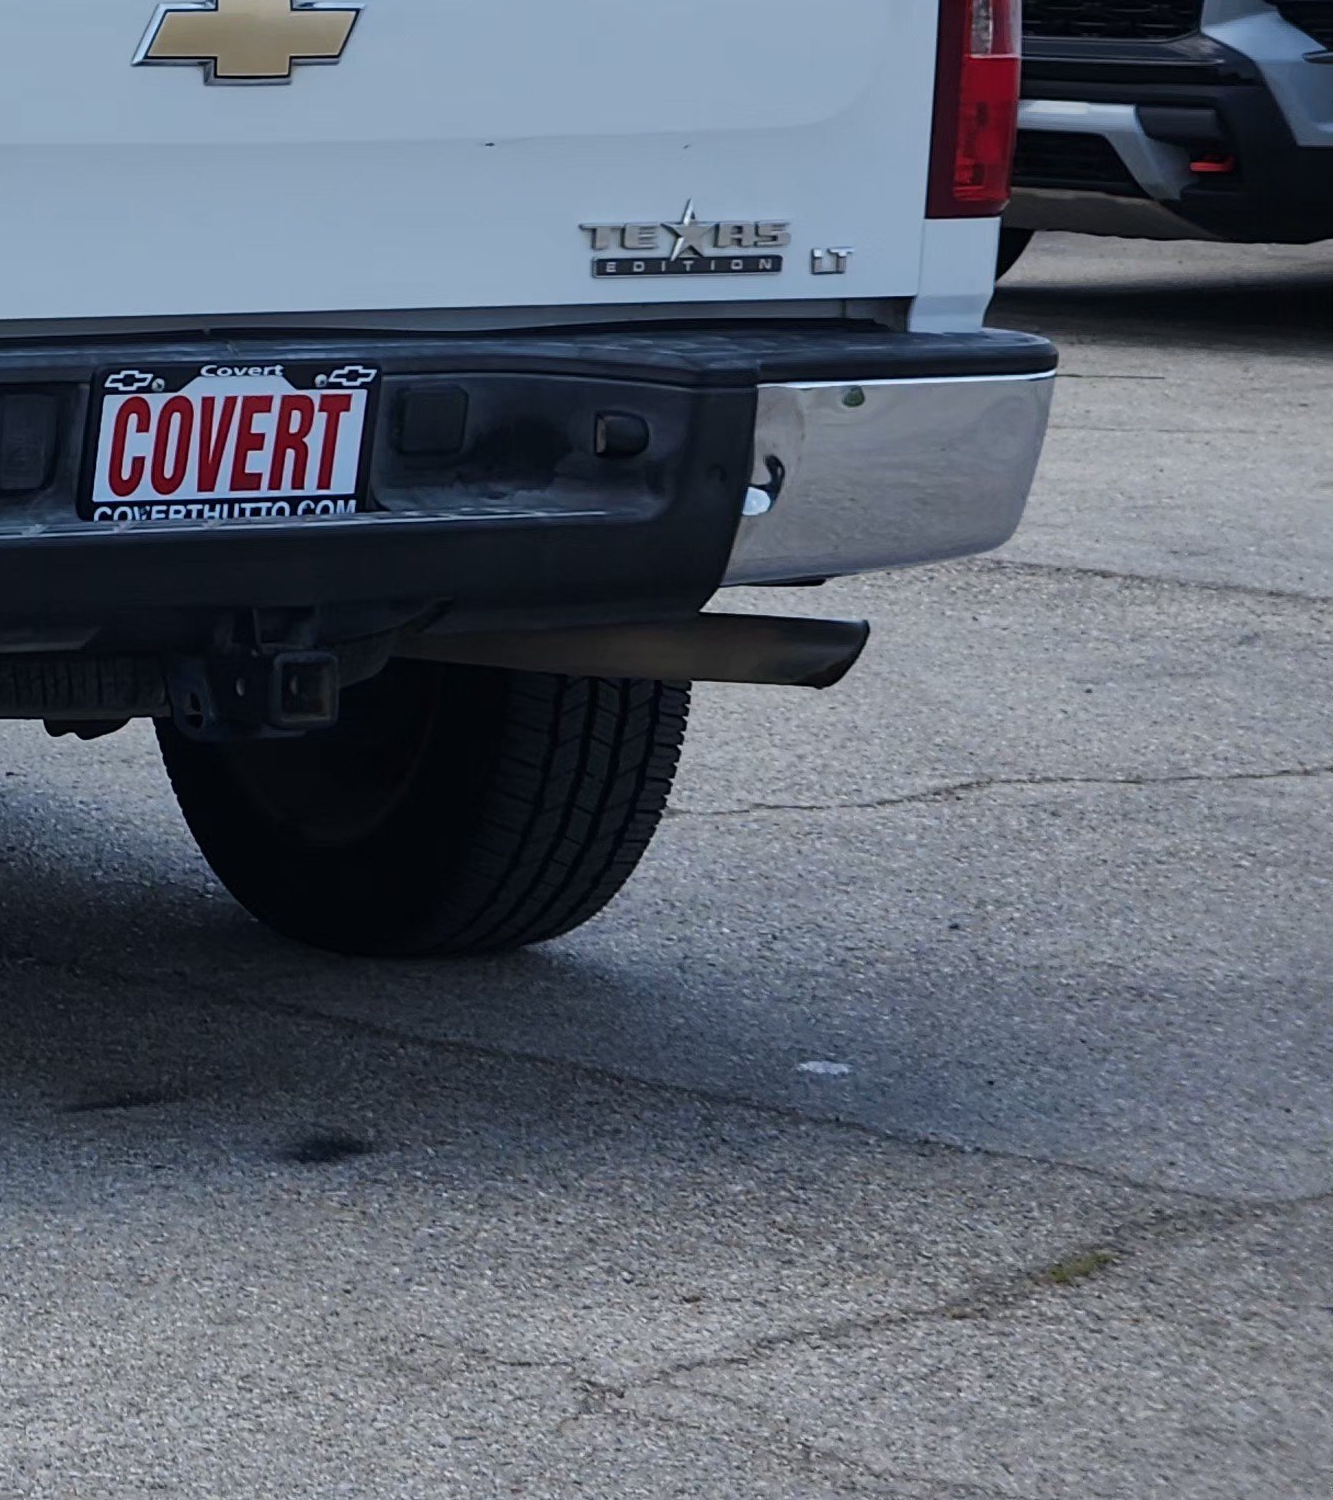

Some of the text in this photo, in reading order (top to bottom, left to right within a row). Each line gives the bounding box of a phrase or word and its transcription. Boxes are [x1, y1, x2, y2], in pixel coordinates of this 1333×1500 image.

[604, 257, 774, 274] EDITION
[810, 246, 854, 275] LT
[199, 363, 285, 378] Covert
[107, 393, 353, 498] COVERT
[93, 499, 357, 522] COVERTHUTTOCOM
